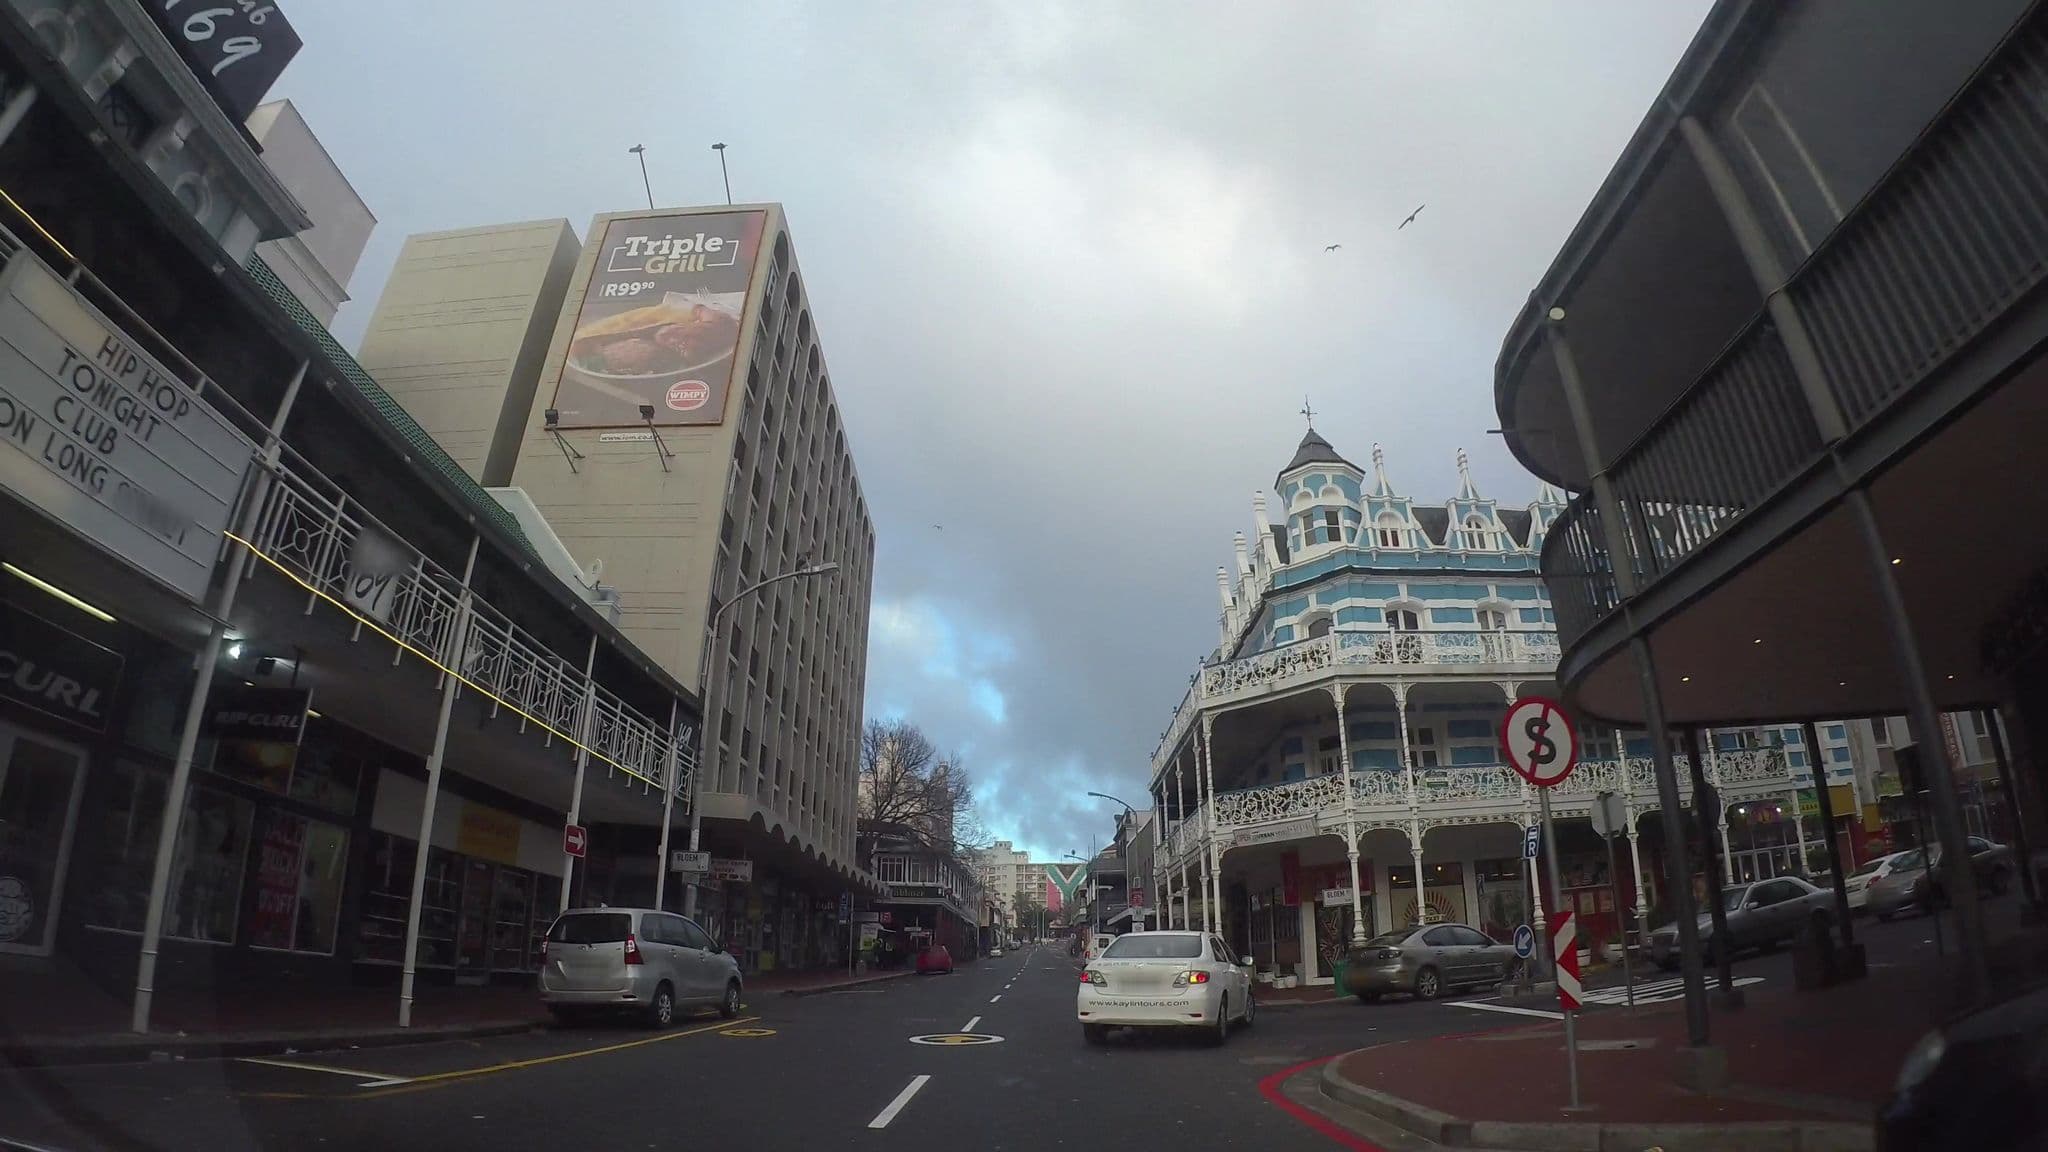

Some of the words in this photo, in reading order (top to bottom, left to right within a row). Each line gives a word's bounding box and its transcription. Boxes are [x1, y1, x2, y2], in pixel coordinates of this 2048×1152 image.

[164, 0, 262, 77] 69
[625, 233, 723, 259] Triple
[645, 255, 706, 274] Grill
[57, 347, 162, 443] TONIGHT
[97, 335, 137, 377] HIP
[138, 369, 191, 421] HOP
[669, 390, 707, 400] WIMPY
[0, 397, 36, 446] ON
[43, 431, 109, 493] LONG
[53, 395, 119, 455] CLUB
[247, 712, 301, 728] CURL
[1088, 999, 1190, 1008] www.kaylintours.com
